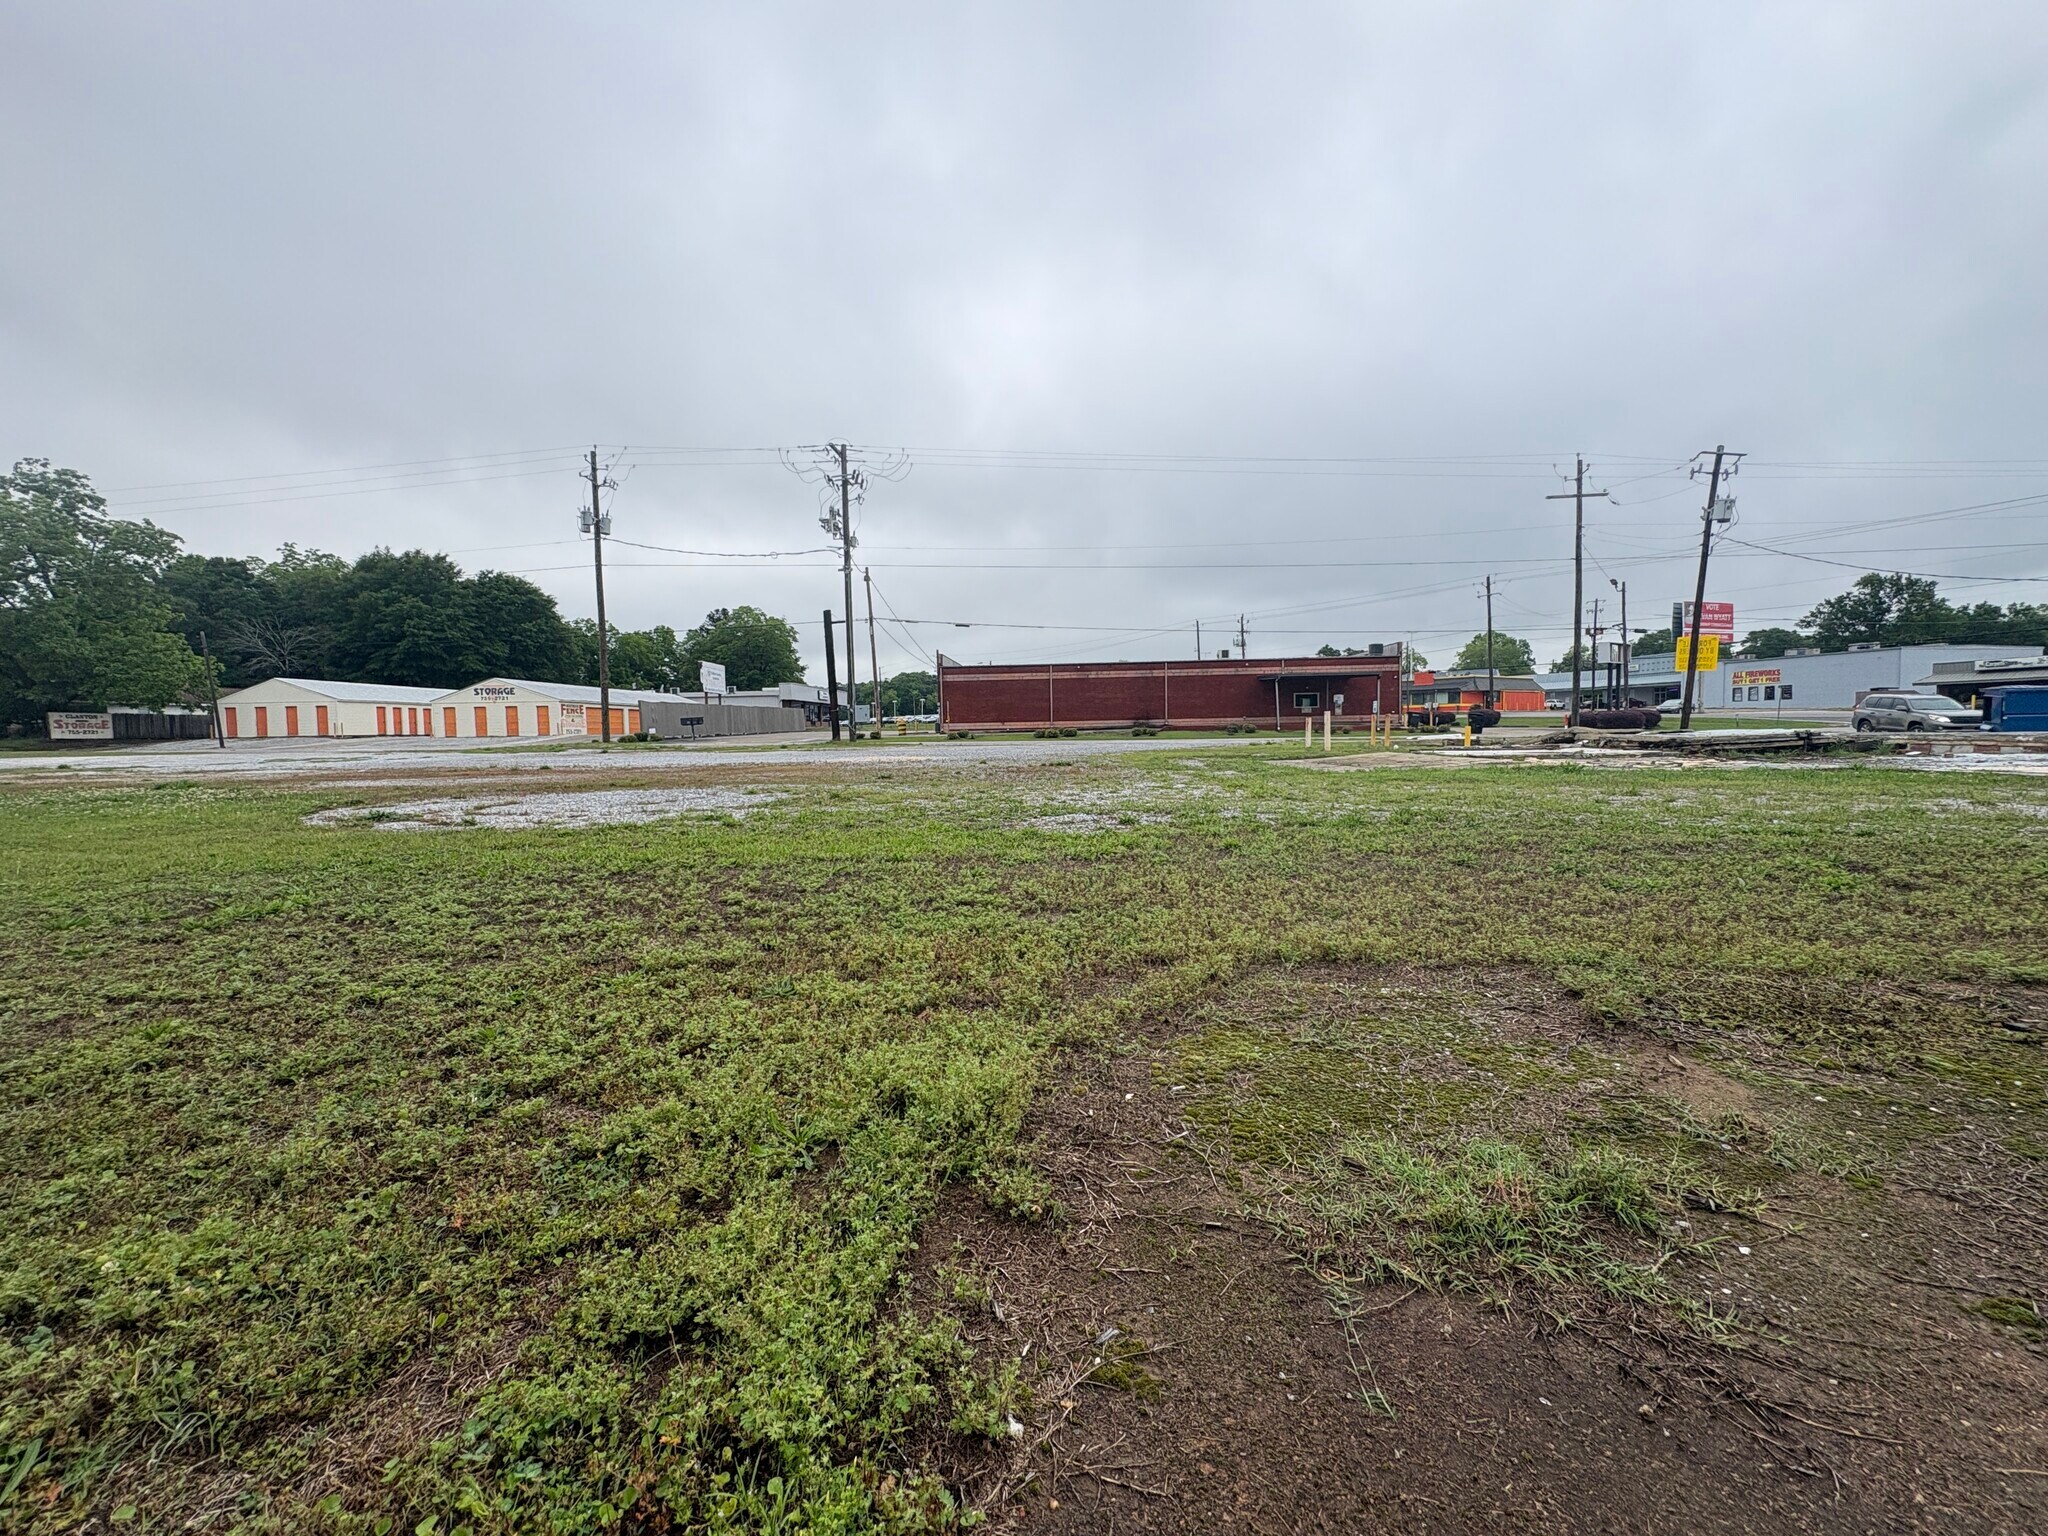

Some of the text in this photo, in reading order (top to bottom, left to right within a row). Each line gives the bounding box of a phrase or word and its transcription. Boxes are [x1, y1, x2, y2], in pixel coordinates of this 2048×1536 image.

[1705, 603, 1719, 611] VOTE
[1732, 669, 1781, 679] ALL FIREWORKS
[473, 687, 515, 696] STORAGE
[561, 704, 584, 717] FENCE
[53, 719, 110, 730] STORAGE
